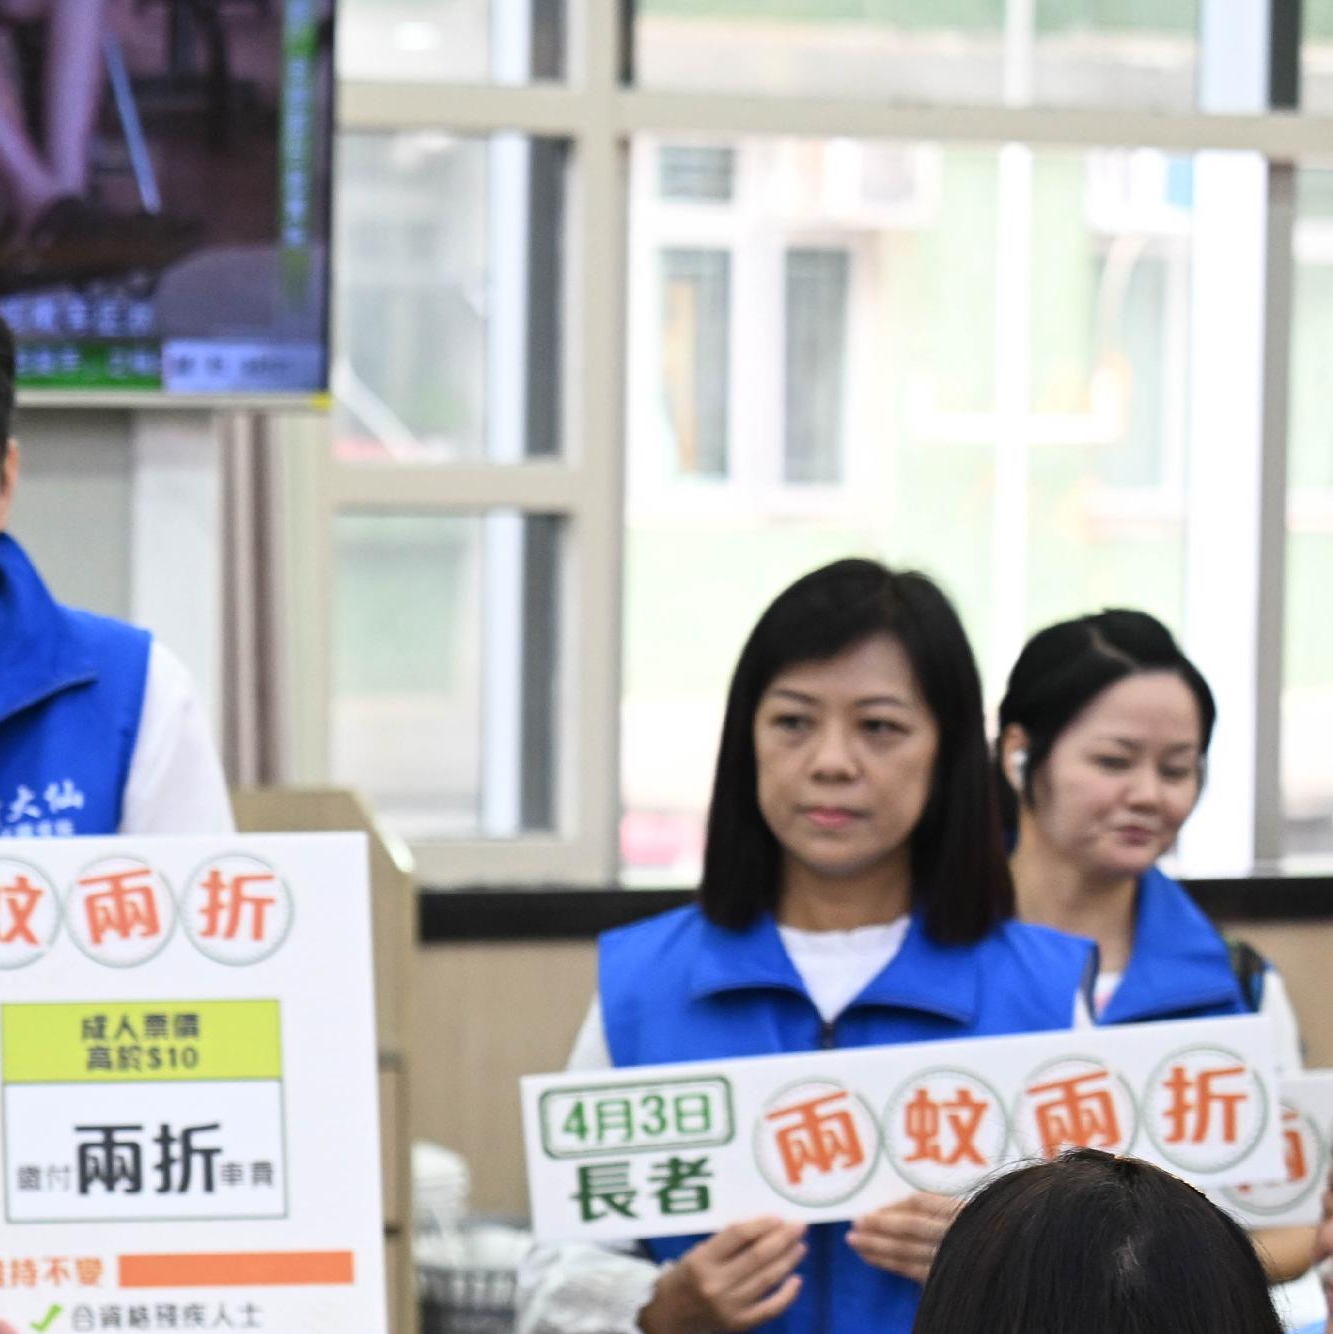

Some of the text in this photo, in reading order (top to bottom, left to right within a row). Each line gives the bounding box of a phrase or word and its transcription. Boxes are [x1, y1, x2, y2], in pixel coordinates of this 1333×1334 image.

[81, 1013, 200, 1041] 成人票價
[86, 1046, 199, 1072] 高於$10
[562, 1092, 712, 1142] 4月3日
[765, 1065, 1248, 1184] 兩蚊兩折
[74, 1122, 223, 1195] 兩折
[221, 1161, 275, 1188] 車費
[571, 1157, 714, 1225] 長者
[71, 1302, 265, 1332] 合資格殘疾人士
